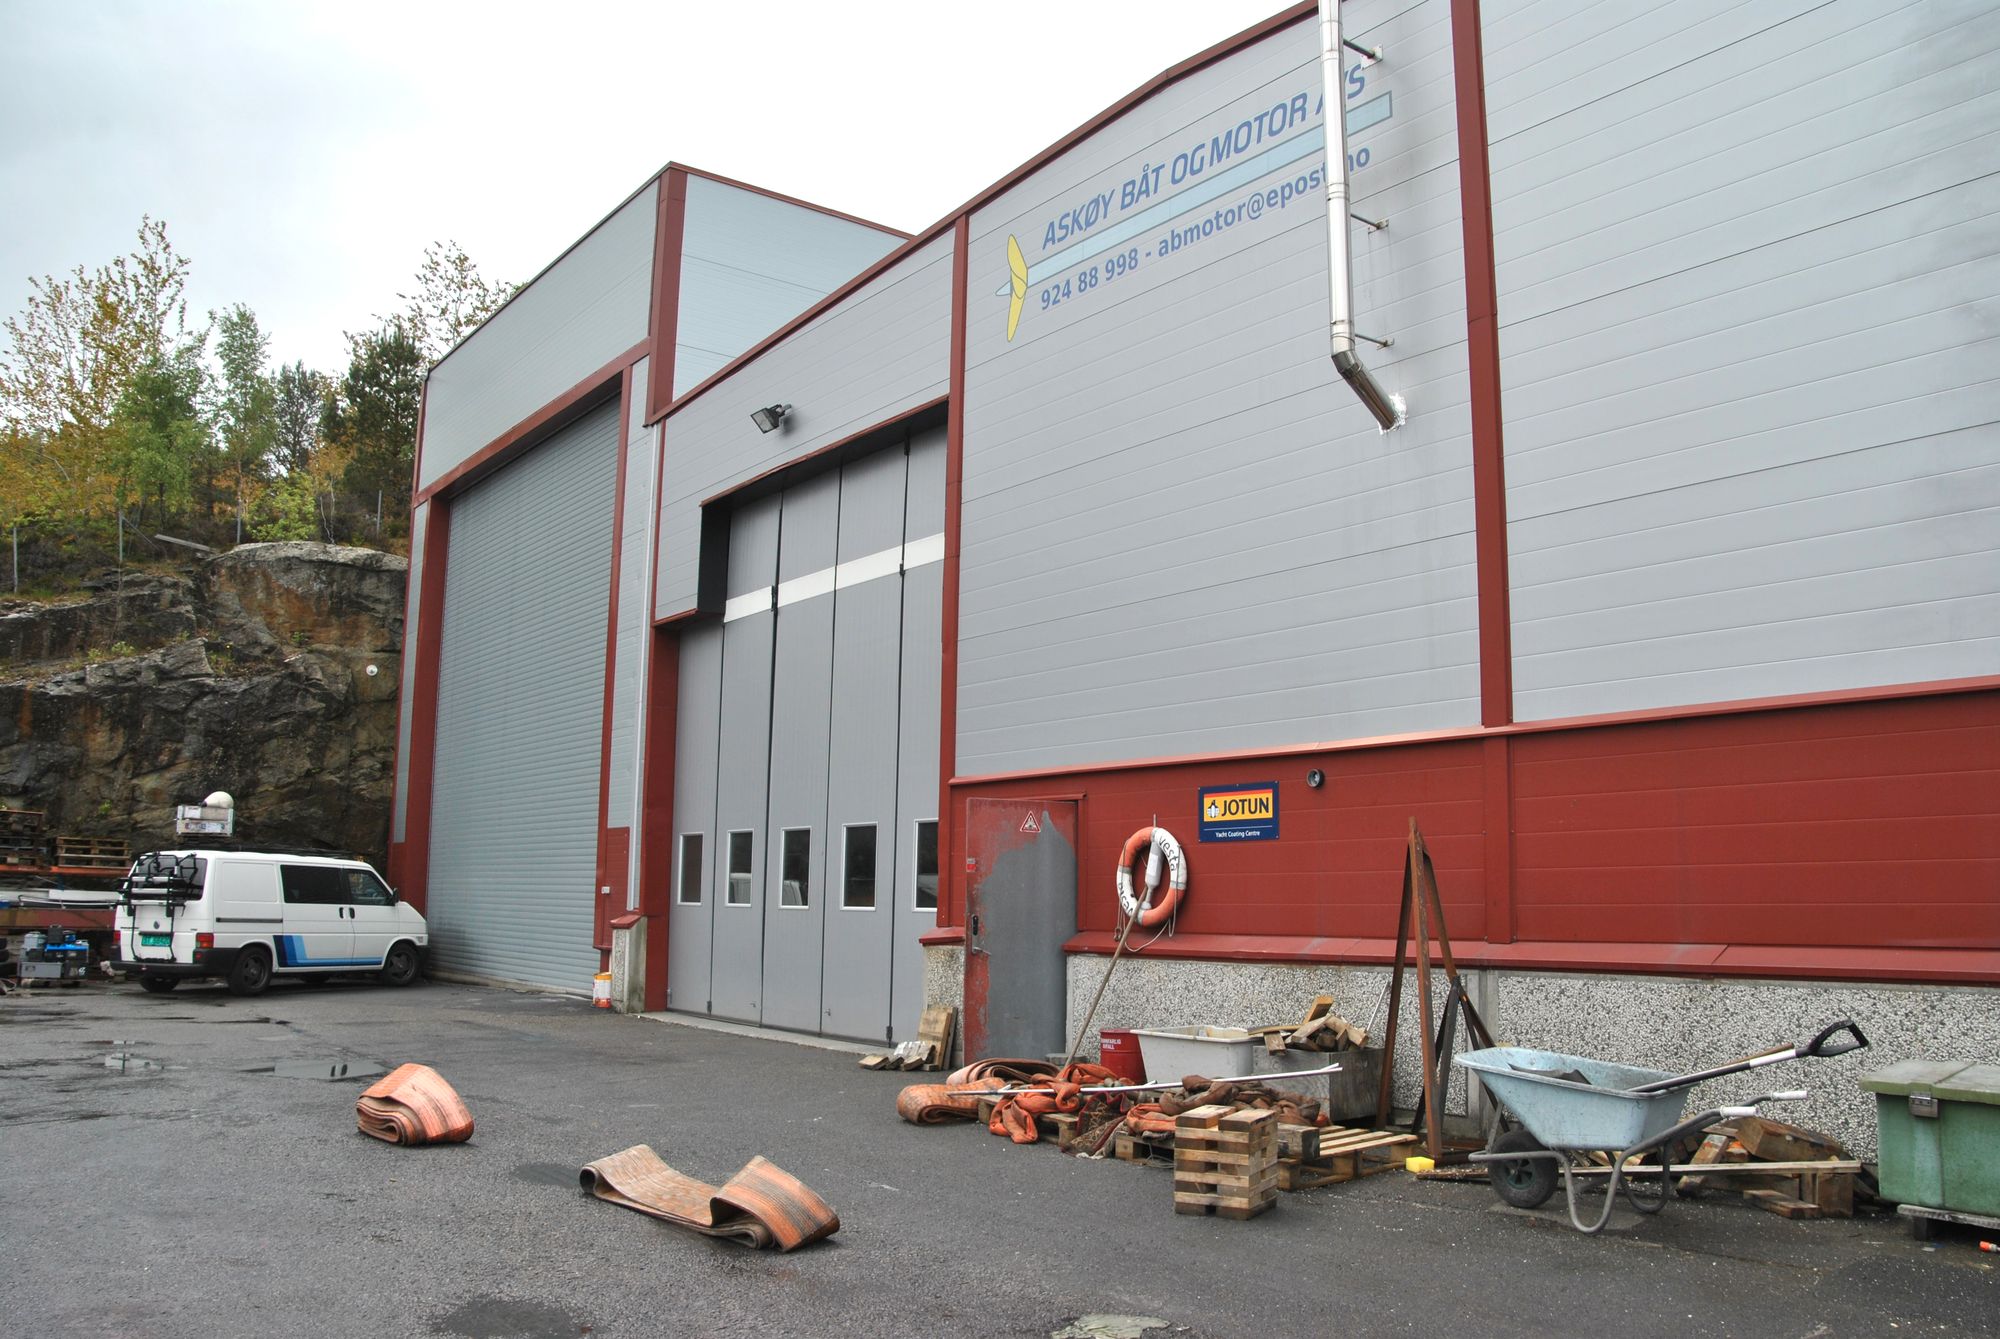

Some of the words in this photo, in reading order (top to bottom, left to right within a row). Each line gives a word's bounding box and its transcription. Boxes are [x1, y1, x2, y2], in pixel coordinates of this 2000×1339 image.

[1042, 188, 1116, 250] ASKØY
[1120, 163, 1165, 211] BÅT
[1170, 143, 1205, 185] OG
[1209, 92, 1307, 167] MOTOR
[1041, 279, 1072, 311] 924
[1078, 266, 1098, 293] 88
[1105, 248, 1139, 281] 998
[1221, 797, 1269, 817] JOTUN
[1228, 830, 1245, 838] Coating
